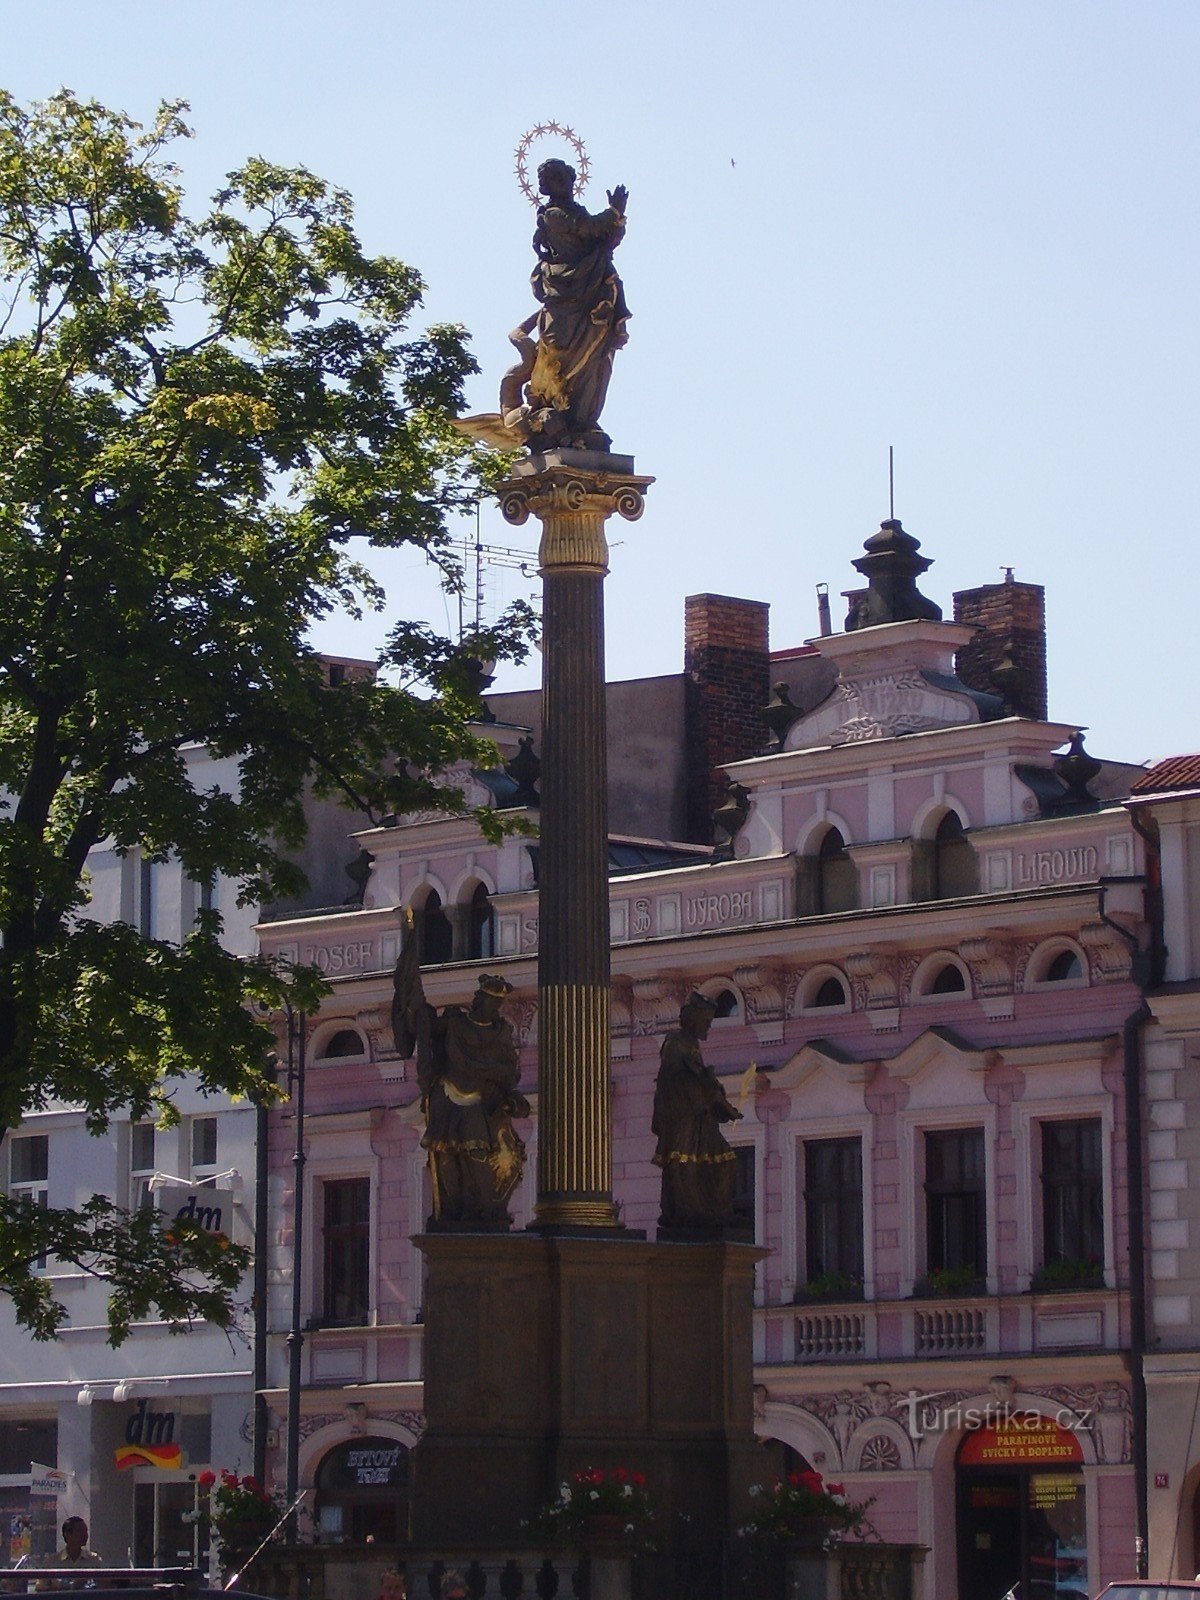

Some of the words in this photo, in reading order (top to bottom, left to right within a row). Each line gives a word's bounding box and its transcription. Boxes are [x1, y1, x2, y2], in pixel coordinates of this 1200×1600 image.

[126, 1398, 175, 1444] dm
[1019, 1448, 1026, 1457] A
[32, 1480, 67, 1489] PARADIES
